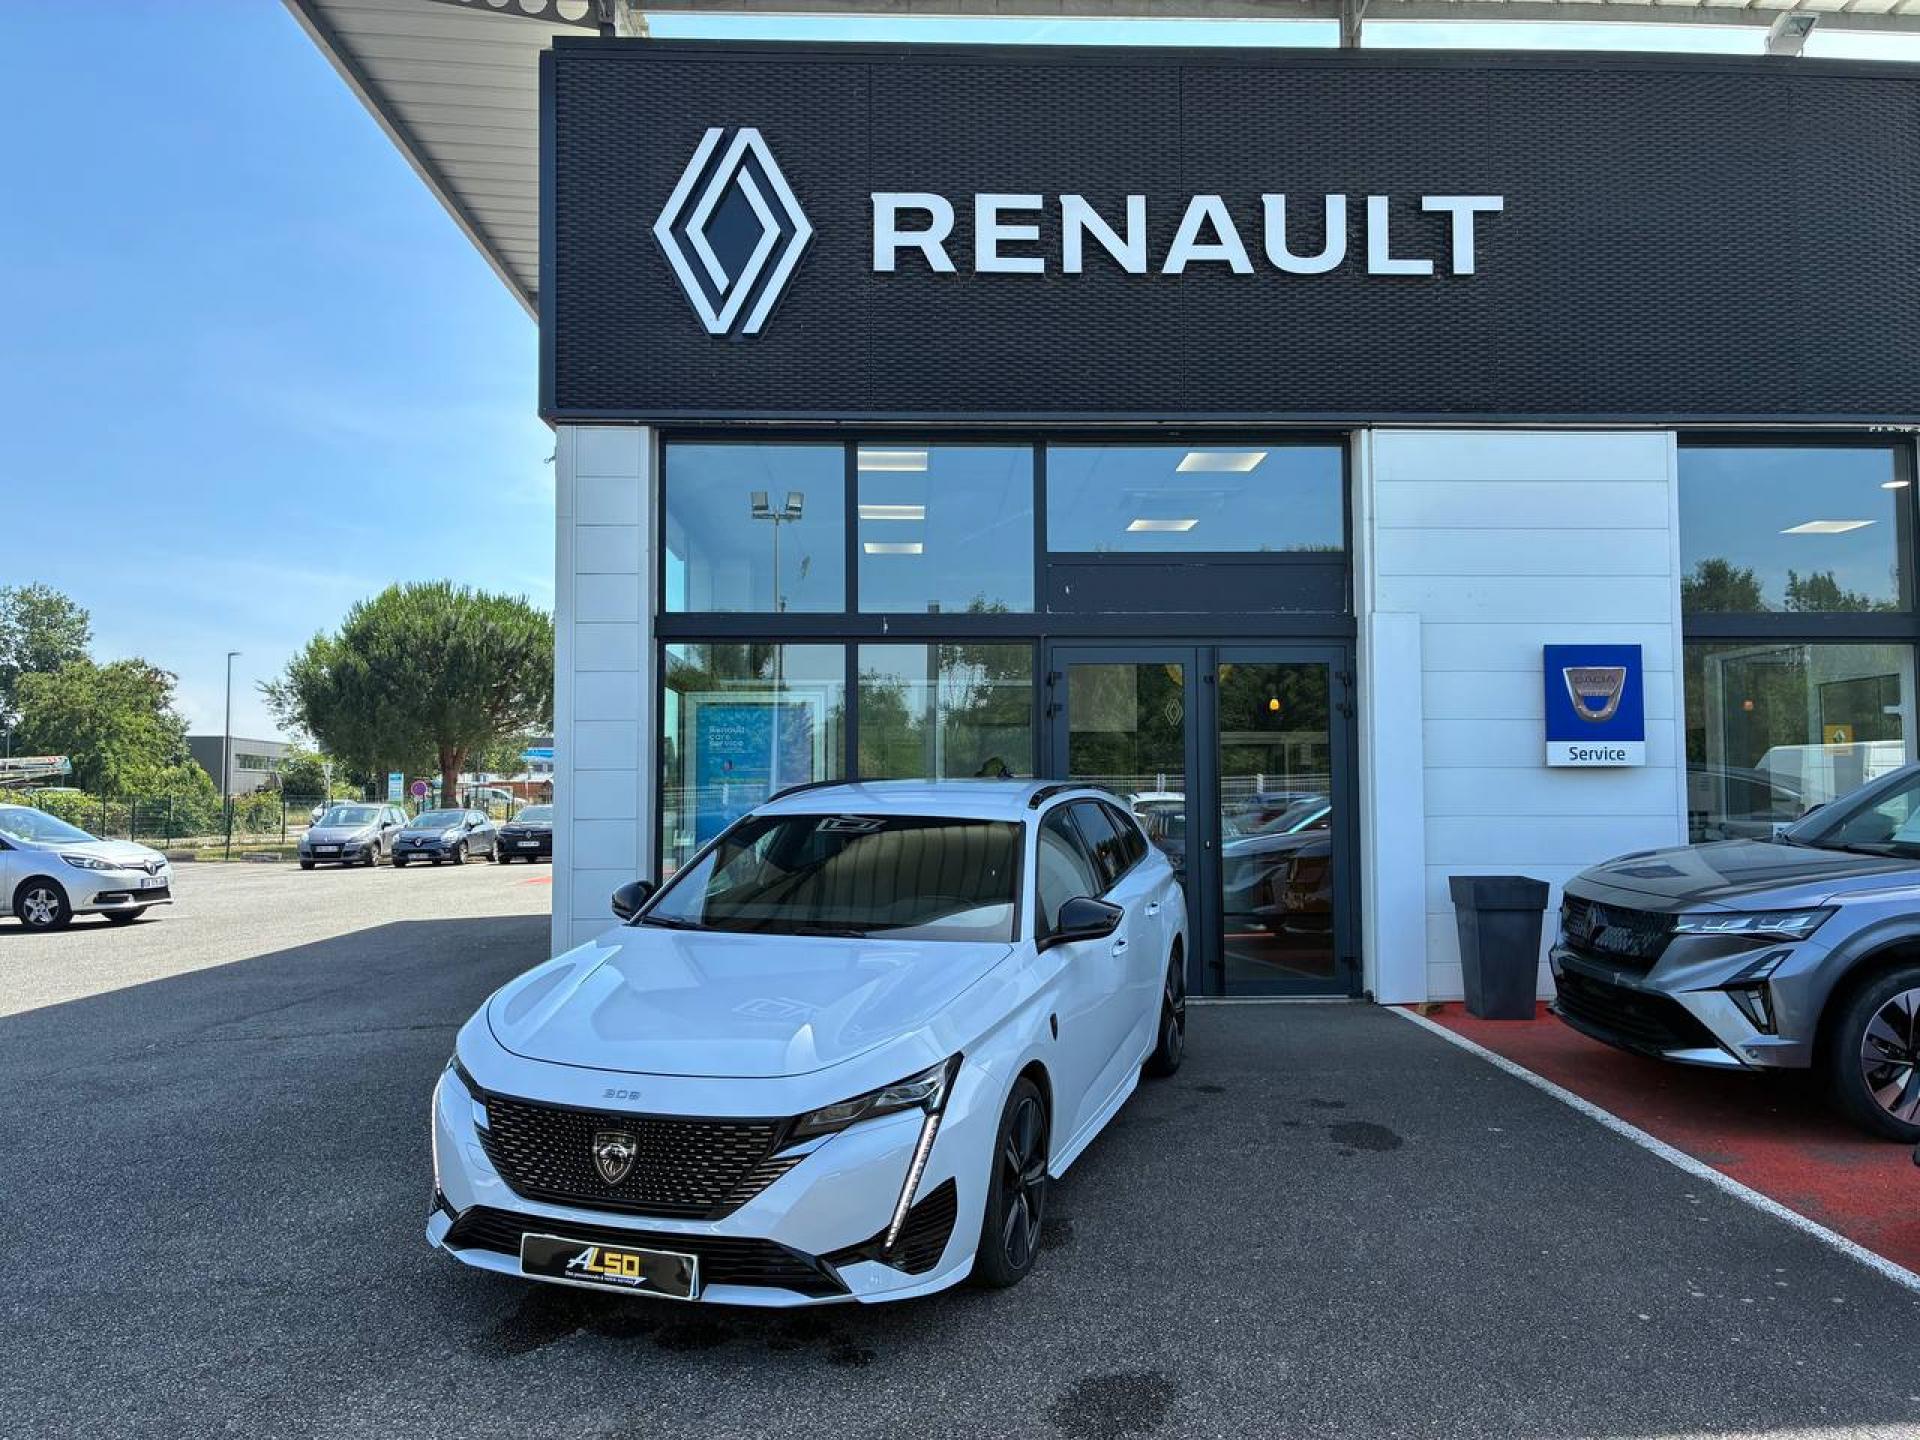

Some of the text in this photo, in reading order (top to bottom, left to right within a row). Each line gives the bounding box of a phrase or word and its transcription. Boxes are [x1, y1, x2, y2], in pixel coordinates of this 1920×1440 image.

[871, 193, 1505, 275] RENAULT
[1568, 746, 1626, 761] Service
[566, 1247, 640, 1276] ALSO
